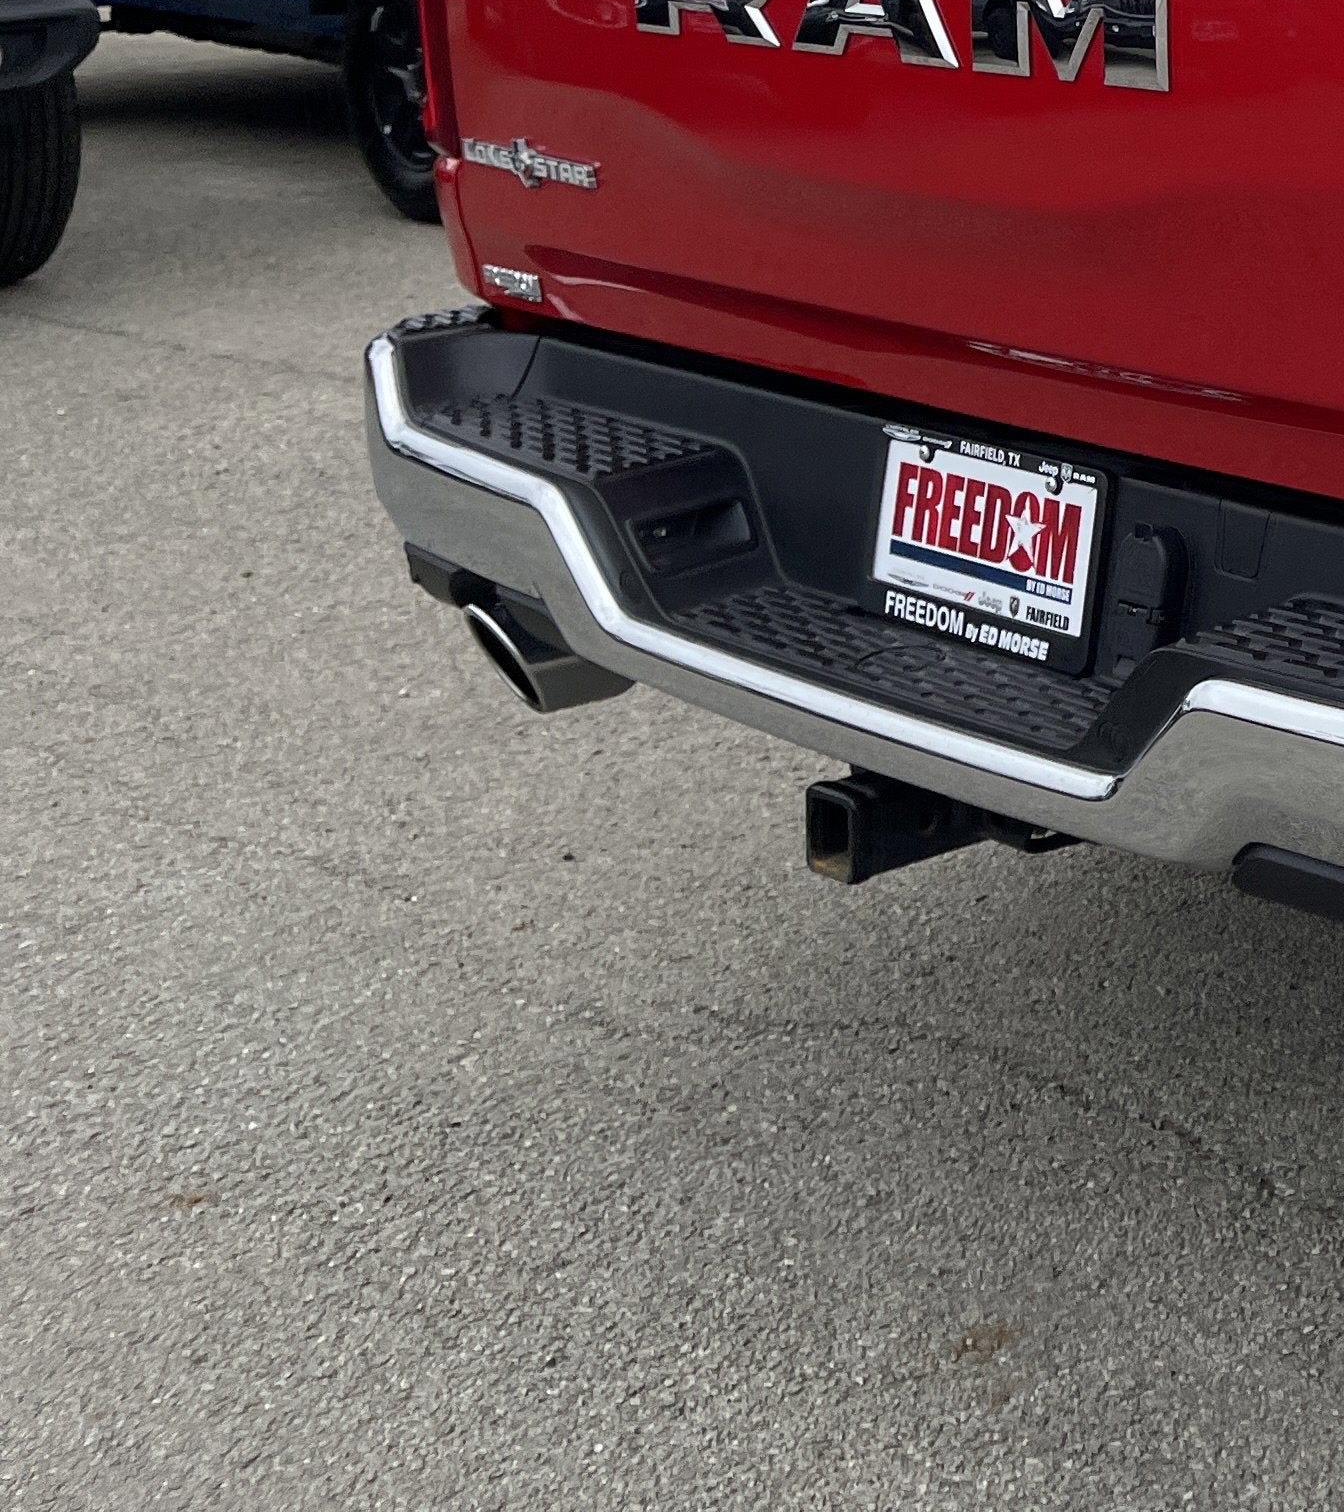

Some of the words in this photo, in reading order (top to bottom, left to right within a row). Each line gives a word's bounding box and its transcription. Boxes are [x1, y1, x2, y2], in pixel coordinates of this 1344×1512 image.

[532, 156, 597, 188] STAR
[960, 440, 1006, 466] FAIRFIELD,
[1008, 451, 1021, 467] TX
[891, 461, 1082, 584] FREEDOM
[884, 590, 965, 637] FREEDOM
[979, 624, 999, 646] ED
[998, 629, 1051, 661] MORSE
[1026, 605, 1070, 631] FAIRFIELD
